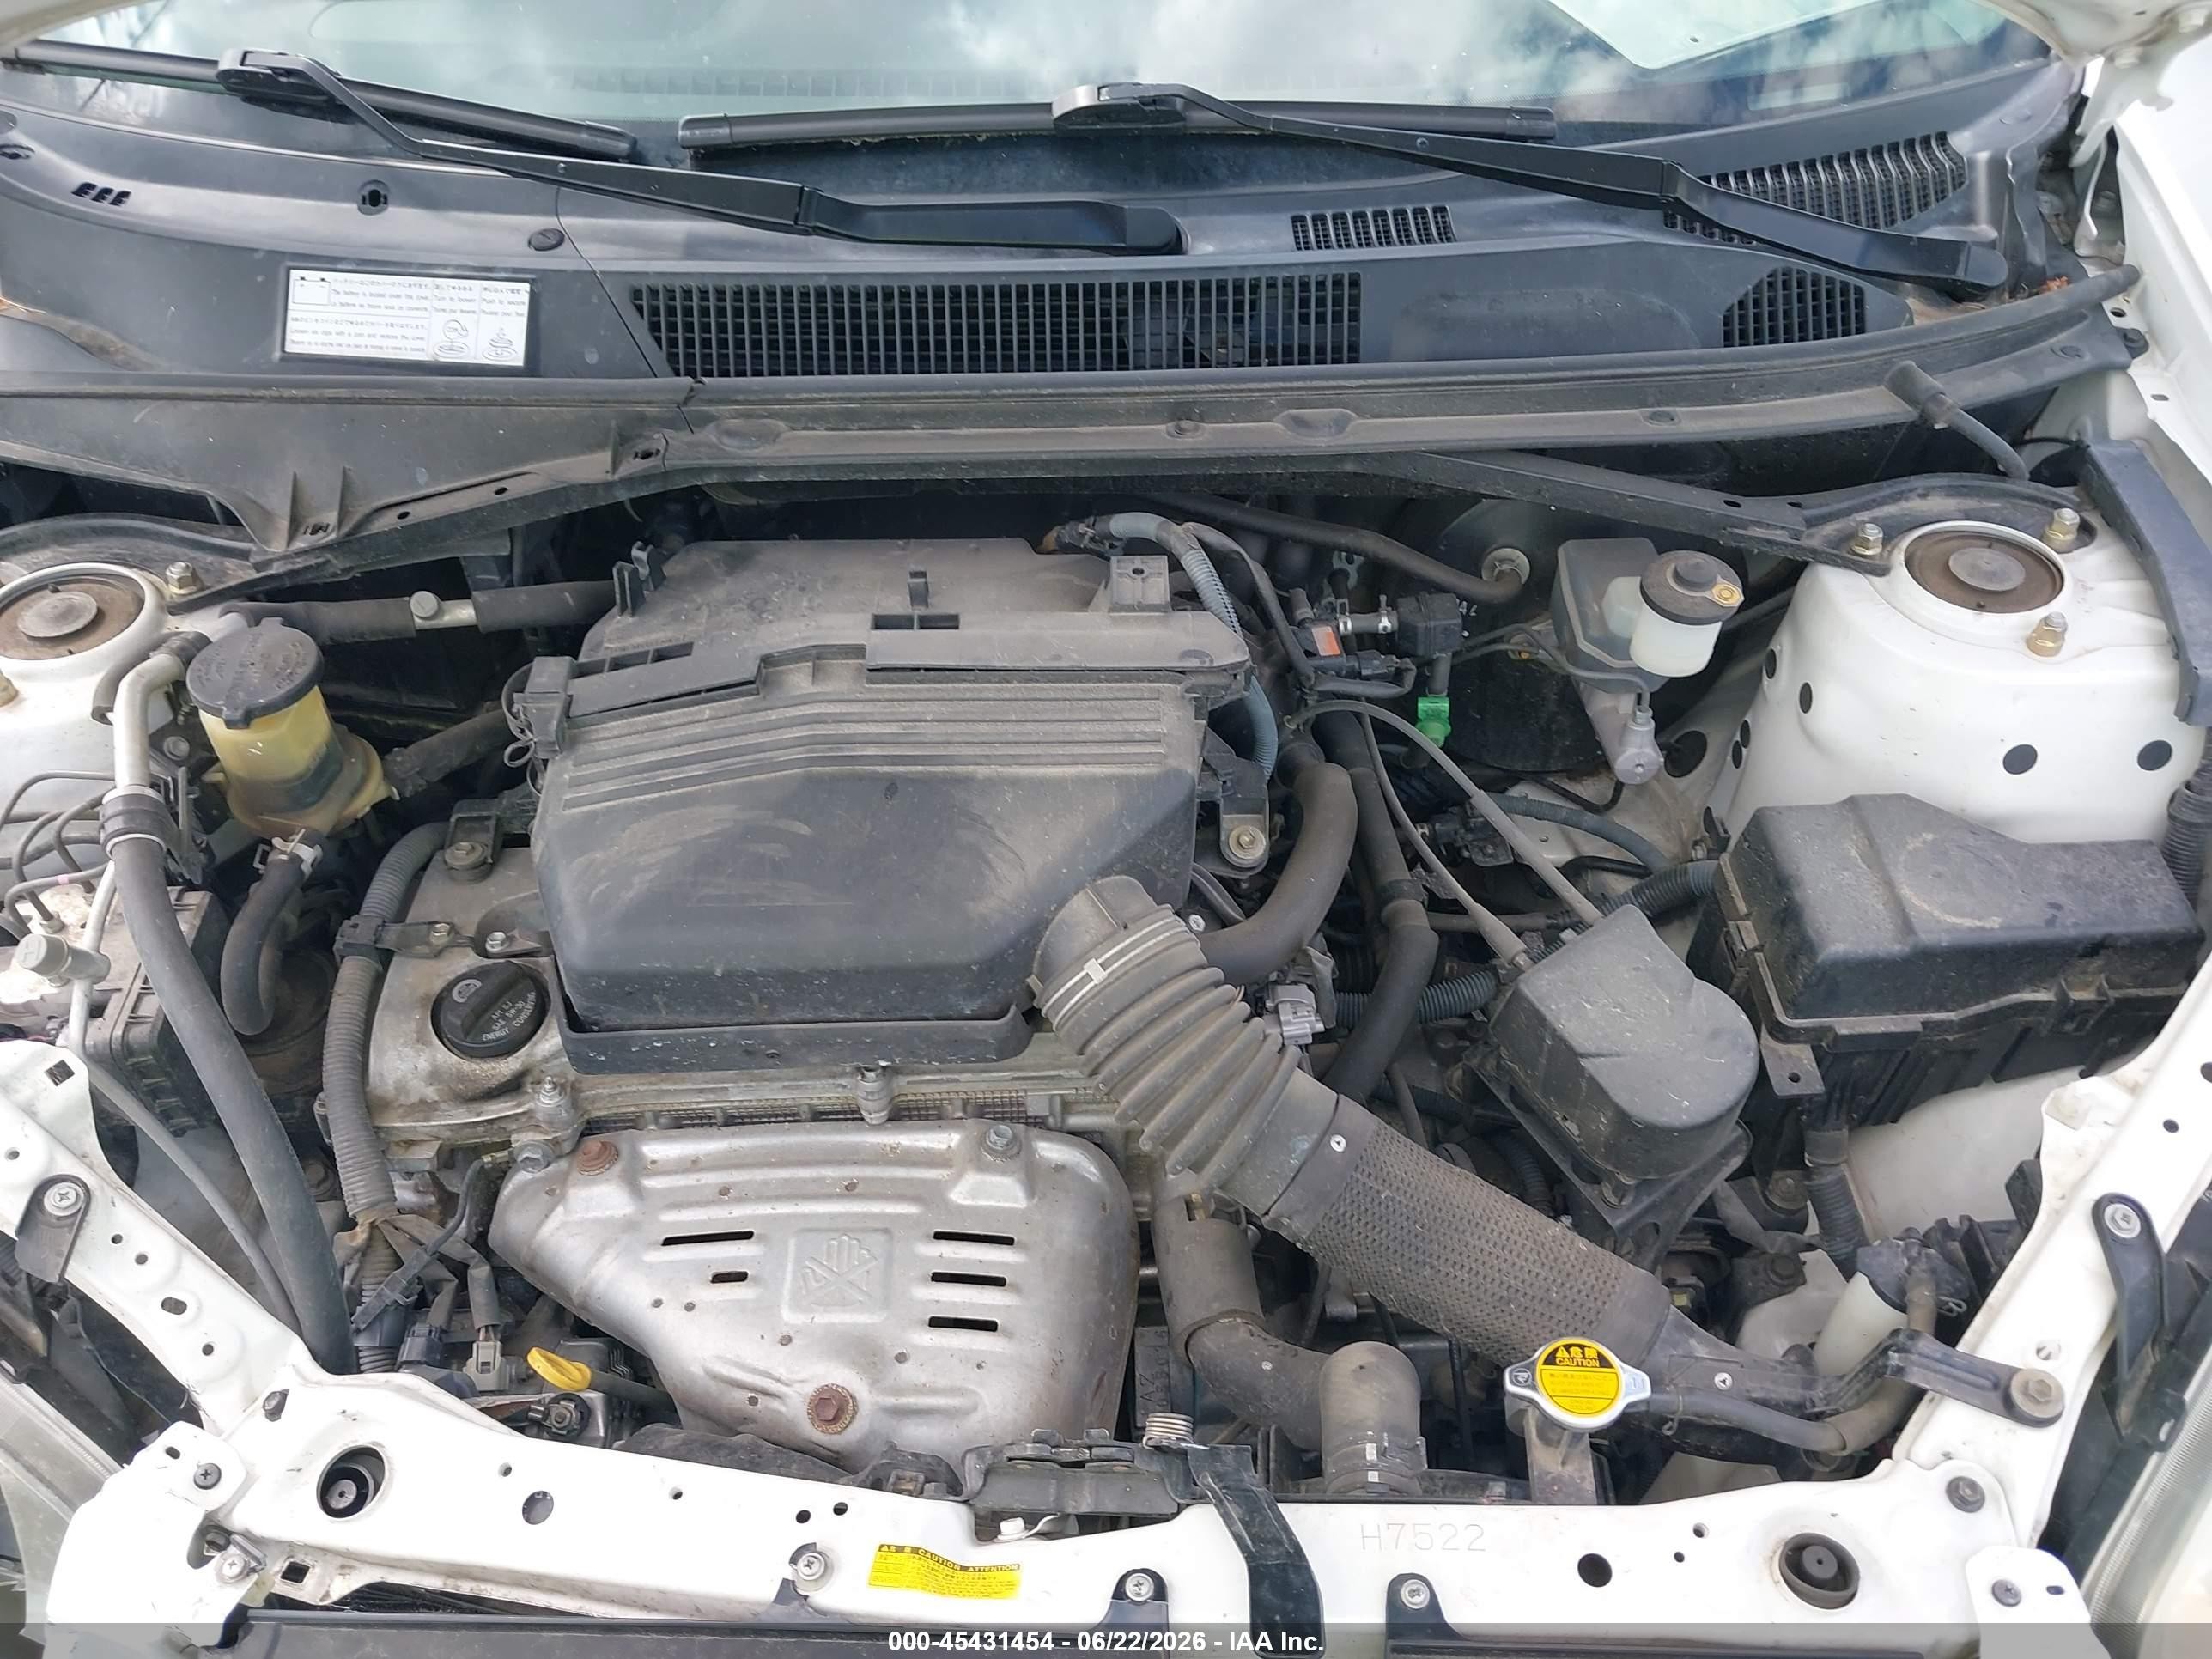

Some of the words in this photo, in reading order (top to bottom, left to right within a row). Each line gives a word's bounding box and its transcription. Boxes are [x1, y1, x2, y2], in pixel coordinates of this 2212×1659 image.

[1555, 1358, 1600, 1368] CAUTION
[1360, 1522, 1486, 1552] H7522
[918, 1548, 961, 1571] CAUTION
[968, 1564, 1018, 1572] ATTENTION
